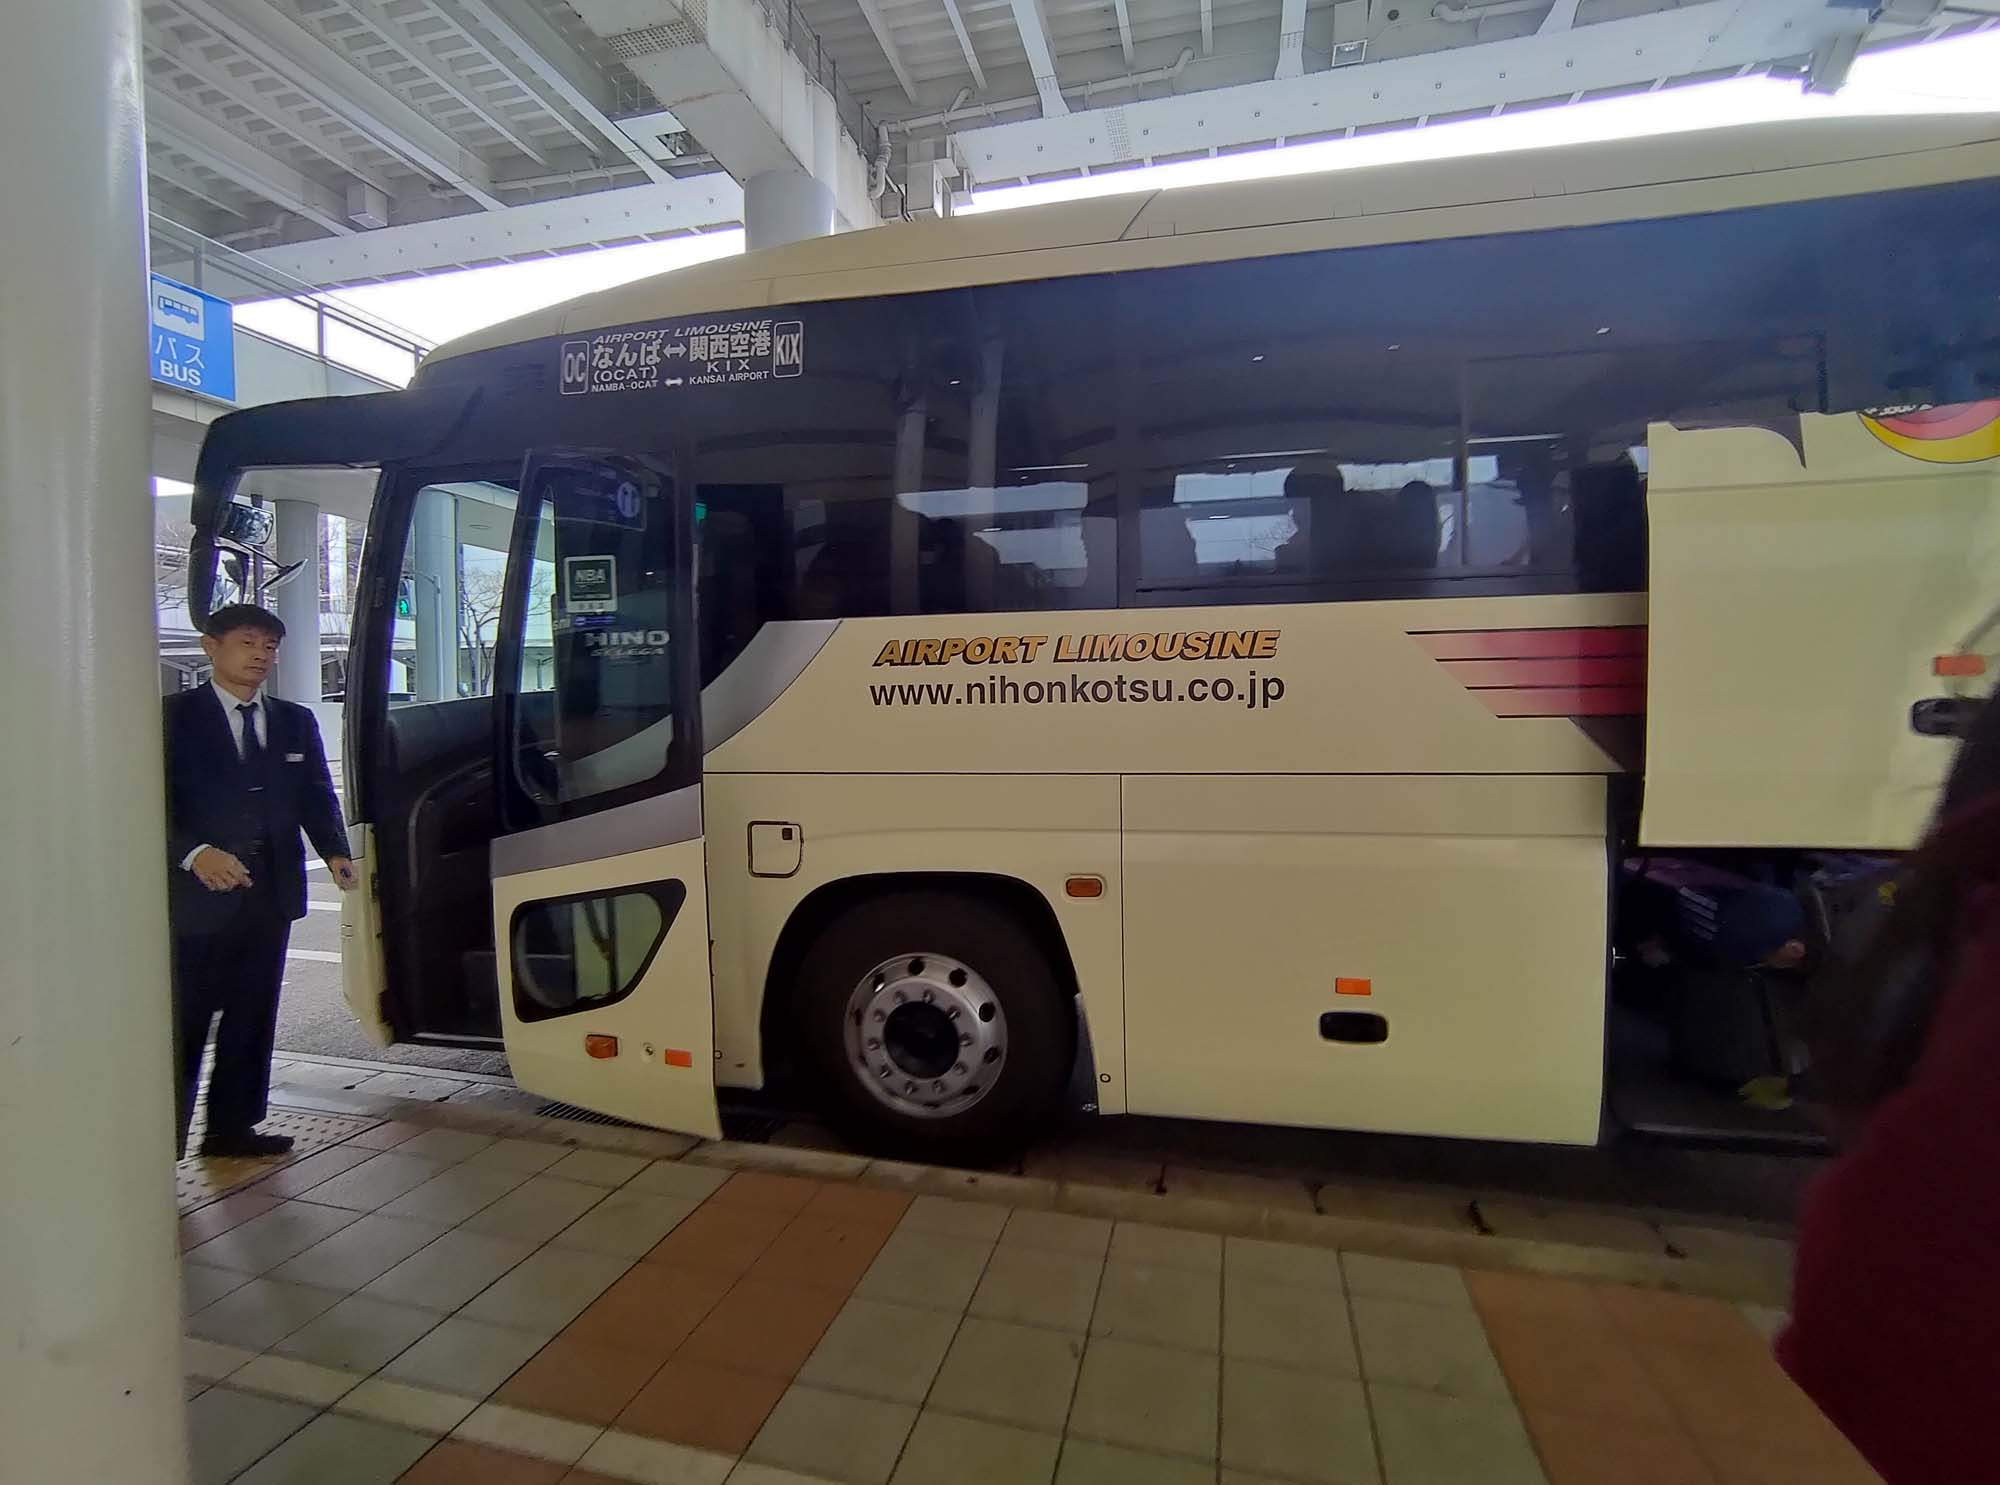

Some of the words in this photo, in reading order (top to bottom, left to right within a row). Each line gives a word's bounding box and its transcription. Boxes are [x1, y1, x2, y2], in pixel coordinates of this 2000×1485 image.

[592, 329, 669, 345] AIRPORT
[674, 320, 773, 337] LIMOUSINE
[155, 334, 205, 369] バス
[592, 339, 663, 370] なんば
[689, 330, 771, 362] 関西空港
[775, 333, 800, 367] KIX
[160, 359, 202, 386] BUS
[564, 352, 587, 384] OC
[592, 379, 659, 393] NAMBA-OCAT
[689, 374, 726, 386] KANSAI
[728, 370, 769, 383] AIRPORT
[593, 365, 658, 384] (OCAT)
[584, 630, 671, 647] HINO
[872, 634, 1048, 667] AIRPORT
[1053, 630, 1281, 664] LIMOUSINE
[869, 669, 1286, 709] www.nihonkotsu.co.jp
